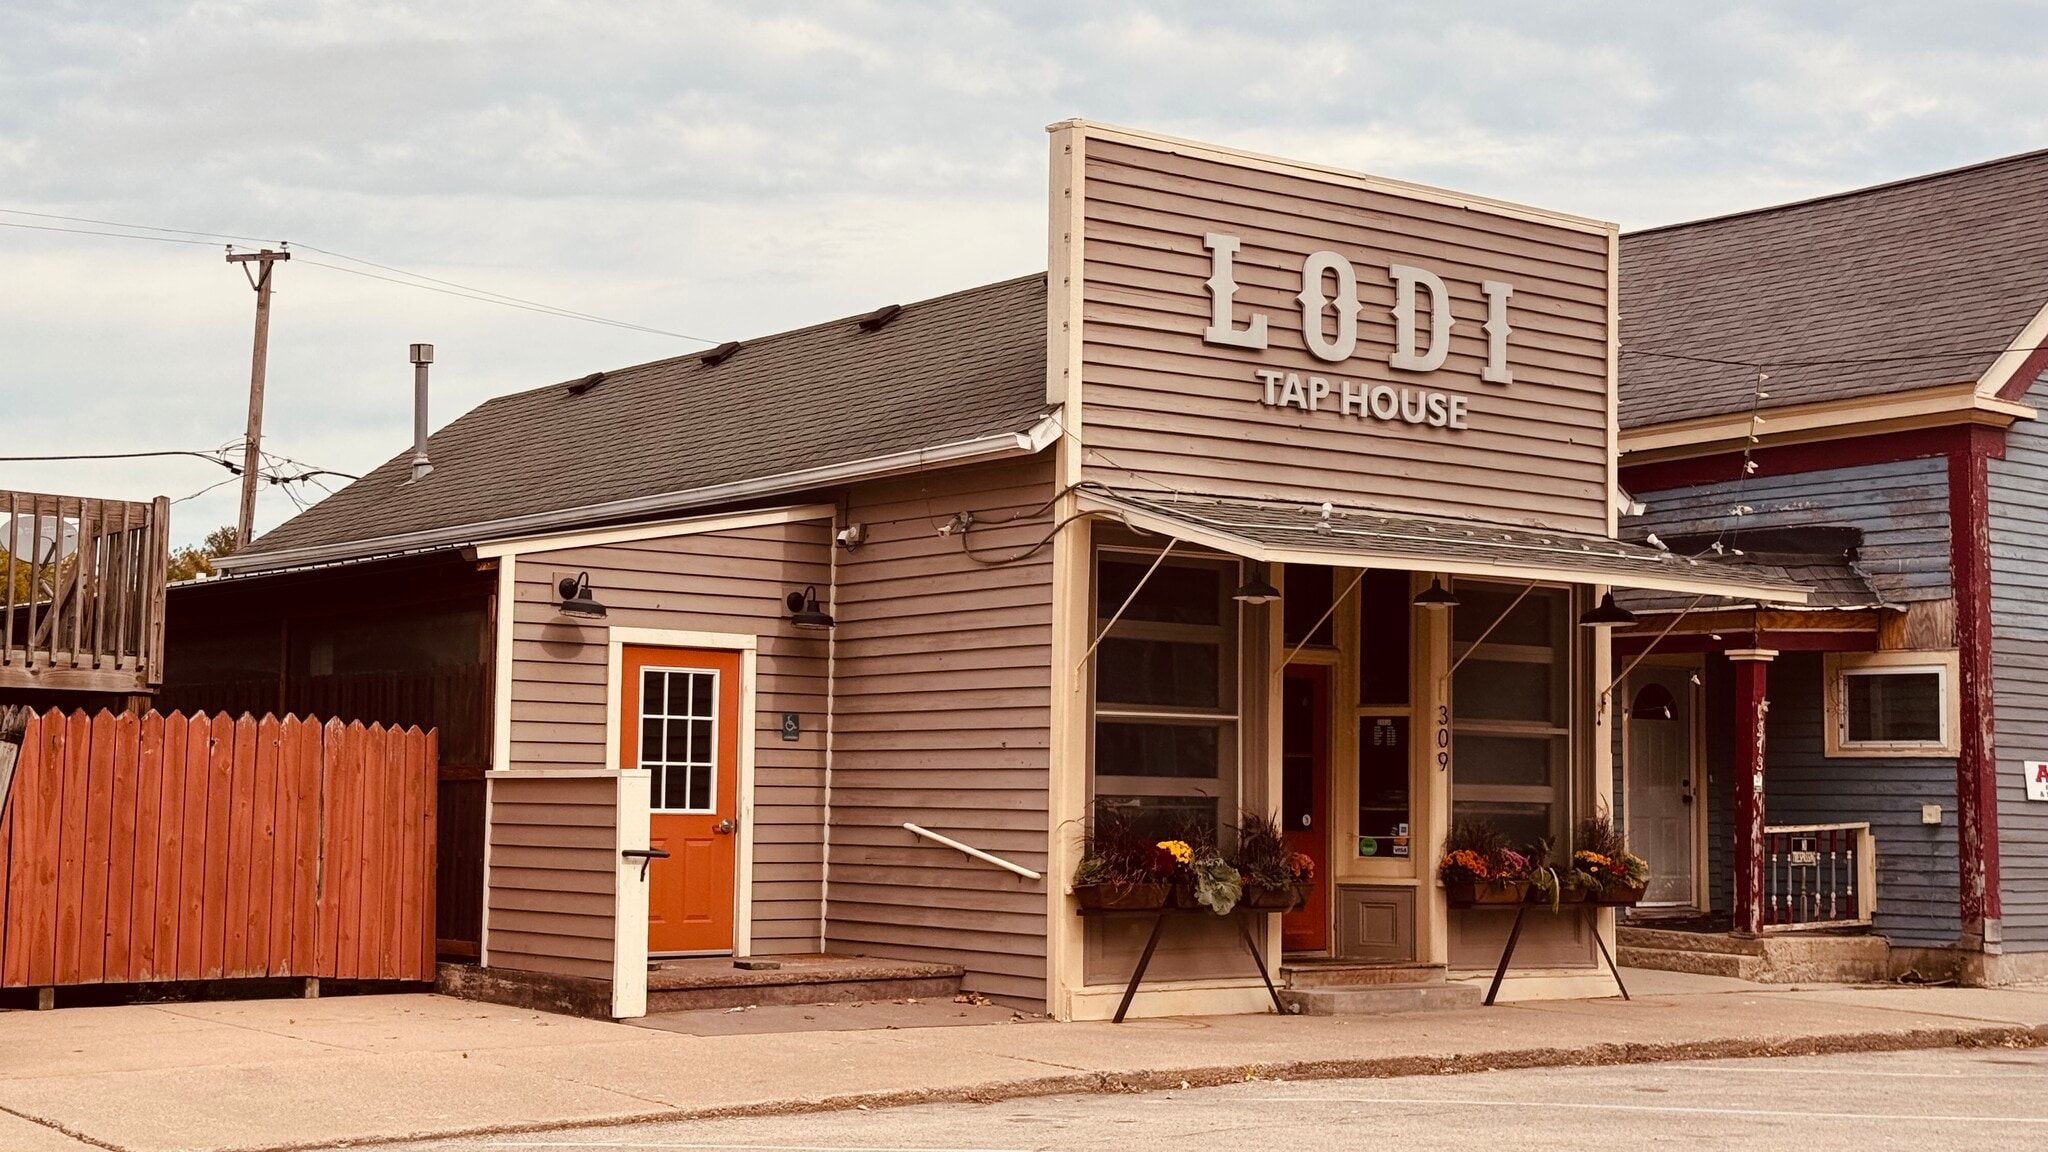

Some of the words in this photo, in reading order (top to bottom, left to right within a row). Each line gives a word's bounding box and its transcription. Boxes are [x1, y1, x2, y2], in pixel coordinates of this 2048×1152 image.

[1203, 232, 1513, 385] LODI
[1256, 369, 1330, 412] TAP
[1340, 380, 1468, 430] HOUSE
[1438, 706, 1448, 771] 309
